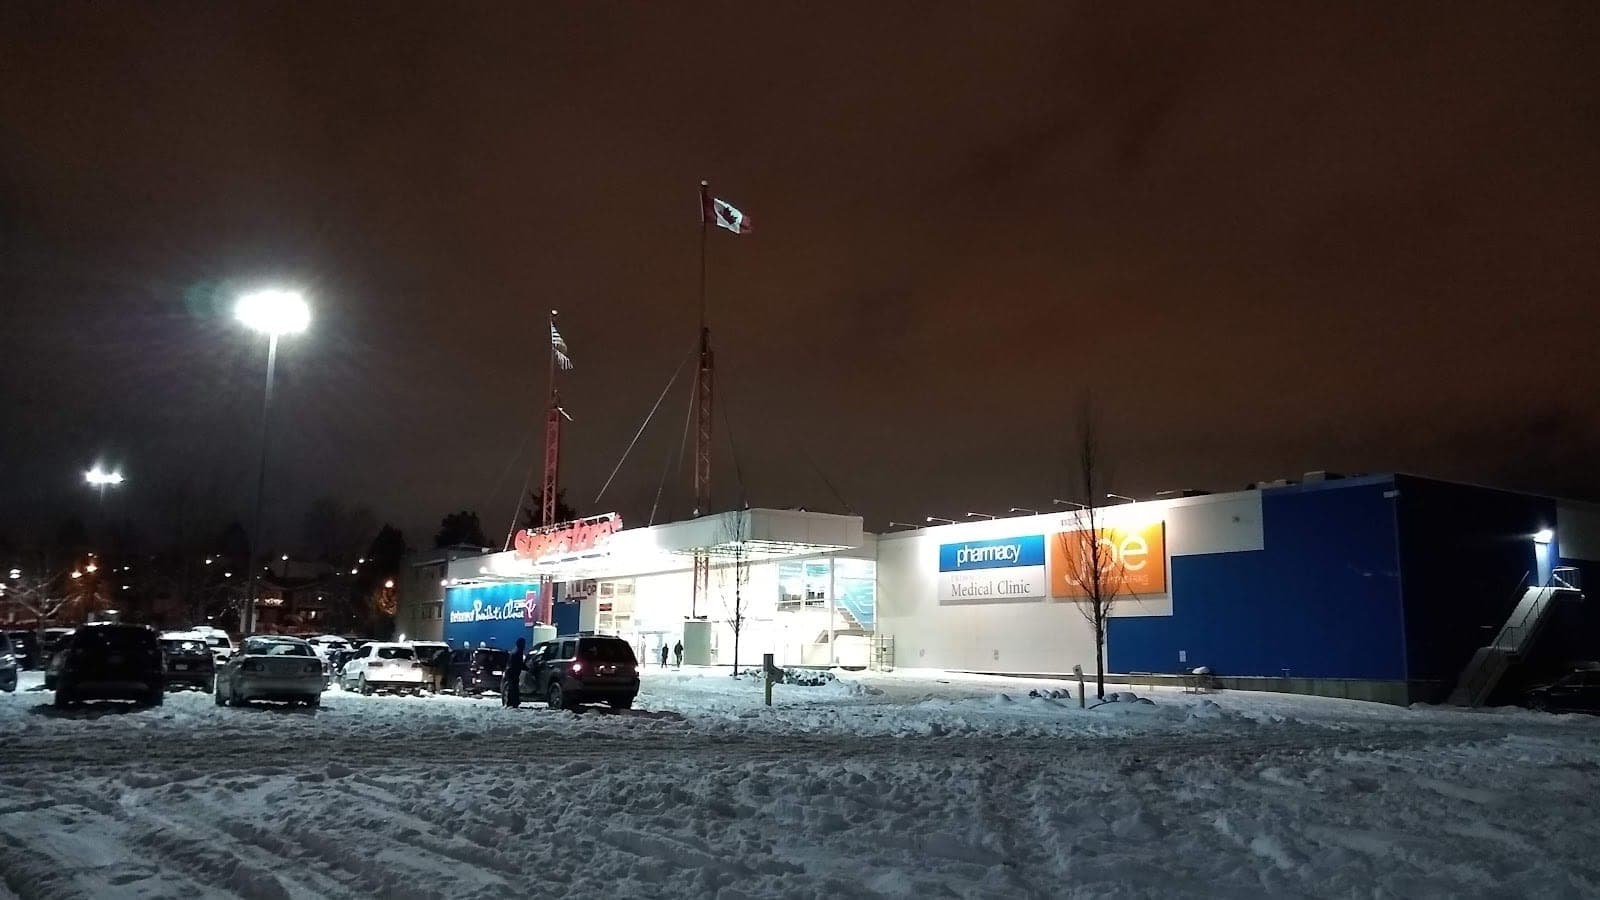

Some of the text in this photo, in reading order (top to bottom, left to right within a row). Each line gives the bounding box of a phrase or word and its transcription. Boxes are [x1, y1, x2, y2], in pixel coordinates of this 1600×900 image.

[956, 543, 1021, 567] pharmacy
[951, 578, 1031, 597] Medical Clinic
